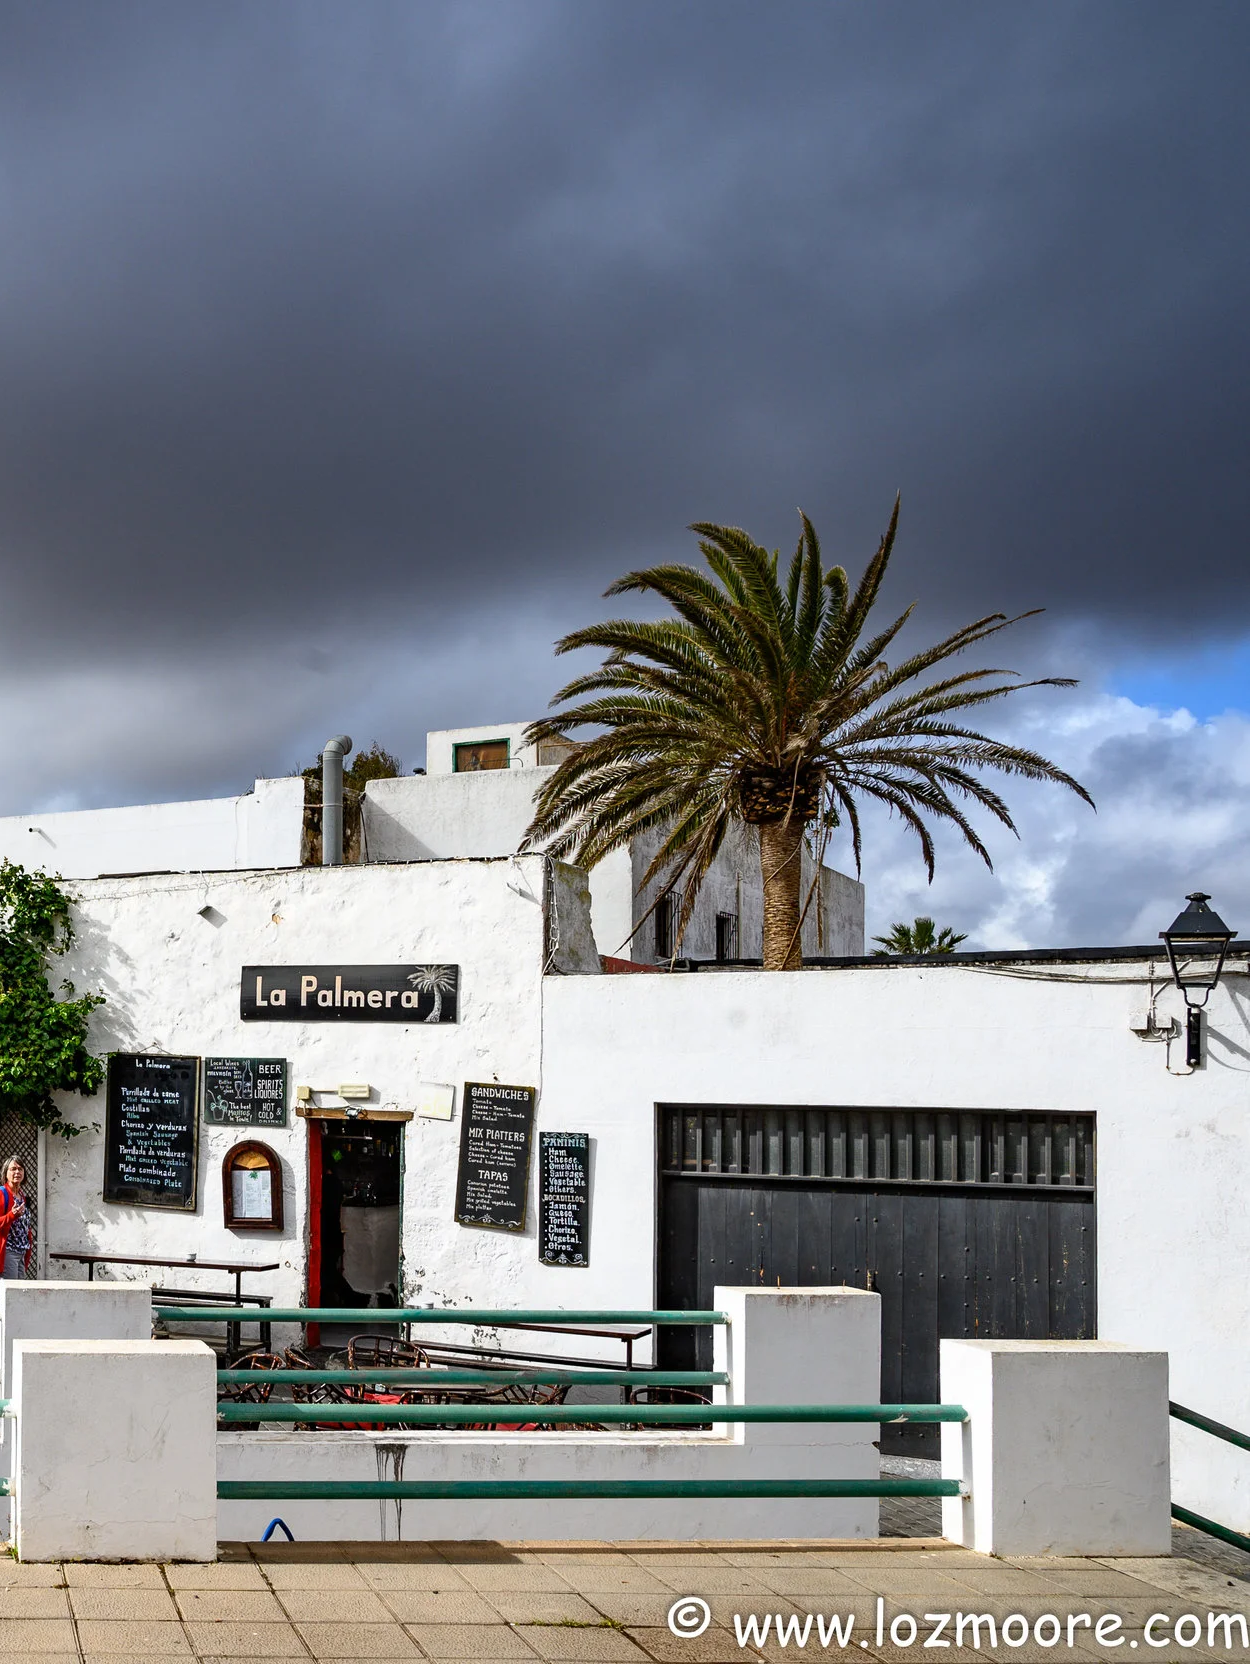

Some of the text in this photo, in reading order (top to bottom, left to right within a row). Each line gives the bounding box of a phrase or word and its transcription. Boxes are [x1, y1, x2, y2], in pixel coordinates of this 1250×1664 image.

[256, 975, 418, 1008] La Palmera
[136, 1059, 170, 1069] La Palmera
[259, 1064, 282, 1074] BEER
[257, 1080, 283, 1090] SPIRITS
[121, 1087, 150, 1096] Parrillada
[153, 1088, 159, 1097] de
[254, 1090, 283, 1099] LIQUORES
[471, 1087, 529, 1101] SANDWICHES
[121, 1103, 150, 1112] Costillas
[240, 1102, 251, 1110] best
[262, 1103, 275, 1111] HOT
[258, 1112, 274, 1120] COLD
[121, 1120, 144, 1128] Chorizo
[156, 1122, 187, 1131] verduras
[126, 1130, 178, 1140] Spanish Sausage
[469, 1127, 525, 1142] MIX PLATTERS
[137, 1139, 171, 1148] Vegetables
[543, 1138, 586, 1147] PANINIS
[119, 1145, 186, 1158] Parrillada de verduras
[119, 1163, 176, 1177] Plato combinado
[478, 1170, 508, 1181] TAPAS
[164, 1179, 182, 1187] Plate
